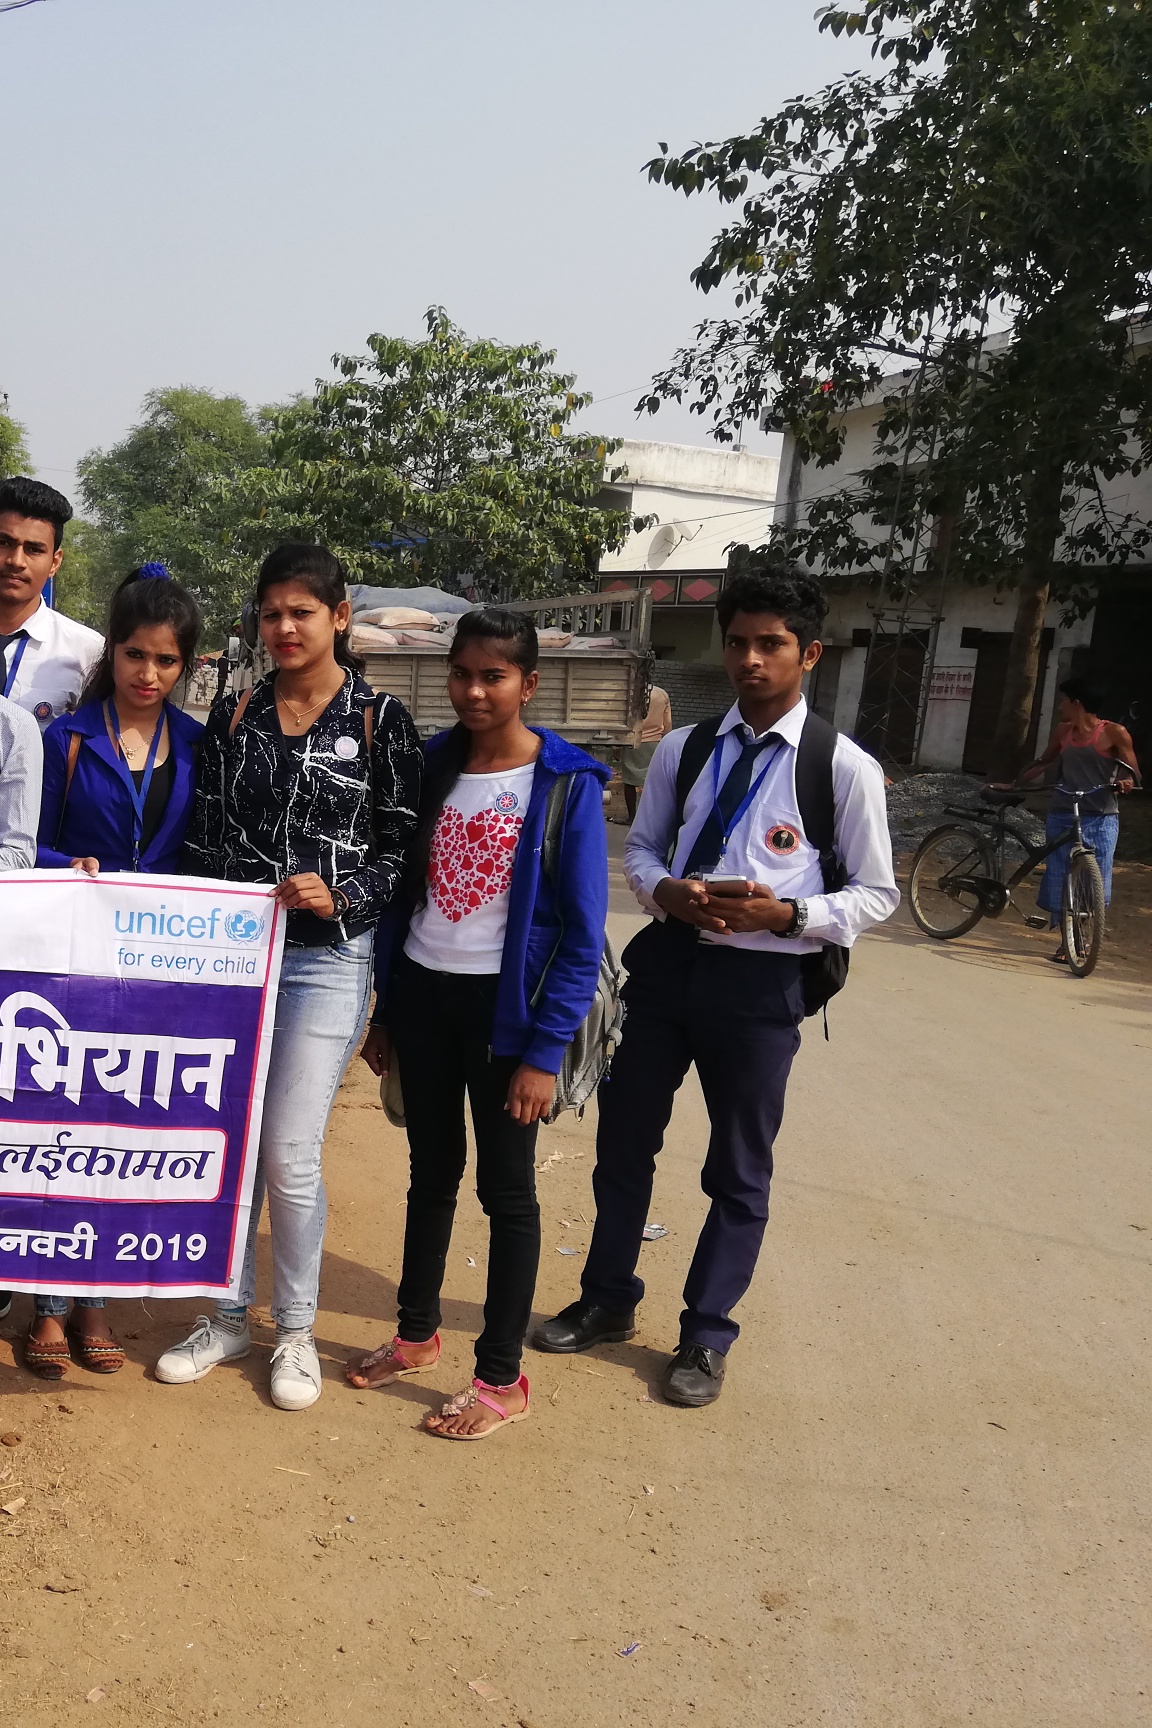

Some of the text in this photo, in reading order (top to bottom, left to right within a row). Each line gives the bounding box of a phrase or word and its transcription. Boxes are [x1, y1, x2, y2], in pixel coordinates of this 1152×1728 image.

[114, 904, 222, 939] unicef
[118, 948, 257, 975] for every child
[115, 1233, 208, 1261] 2019
